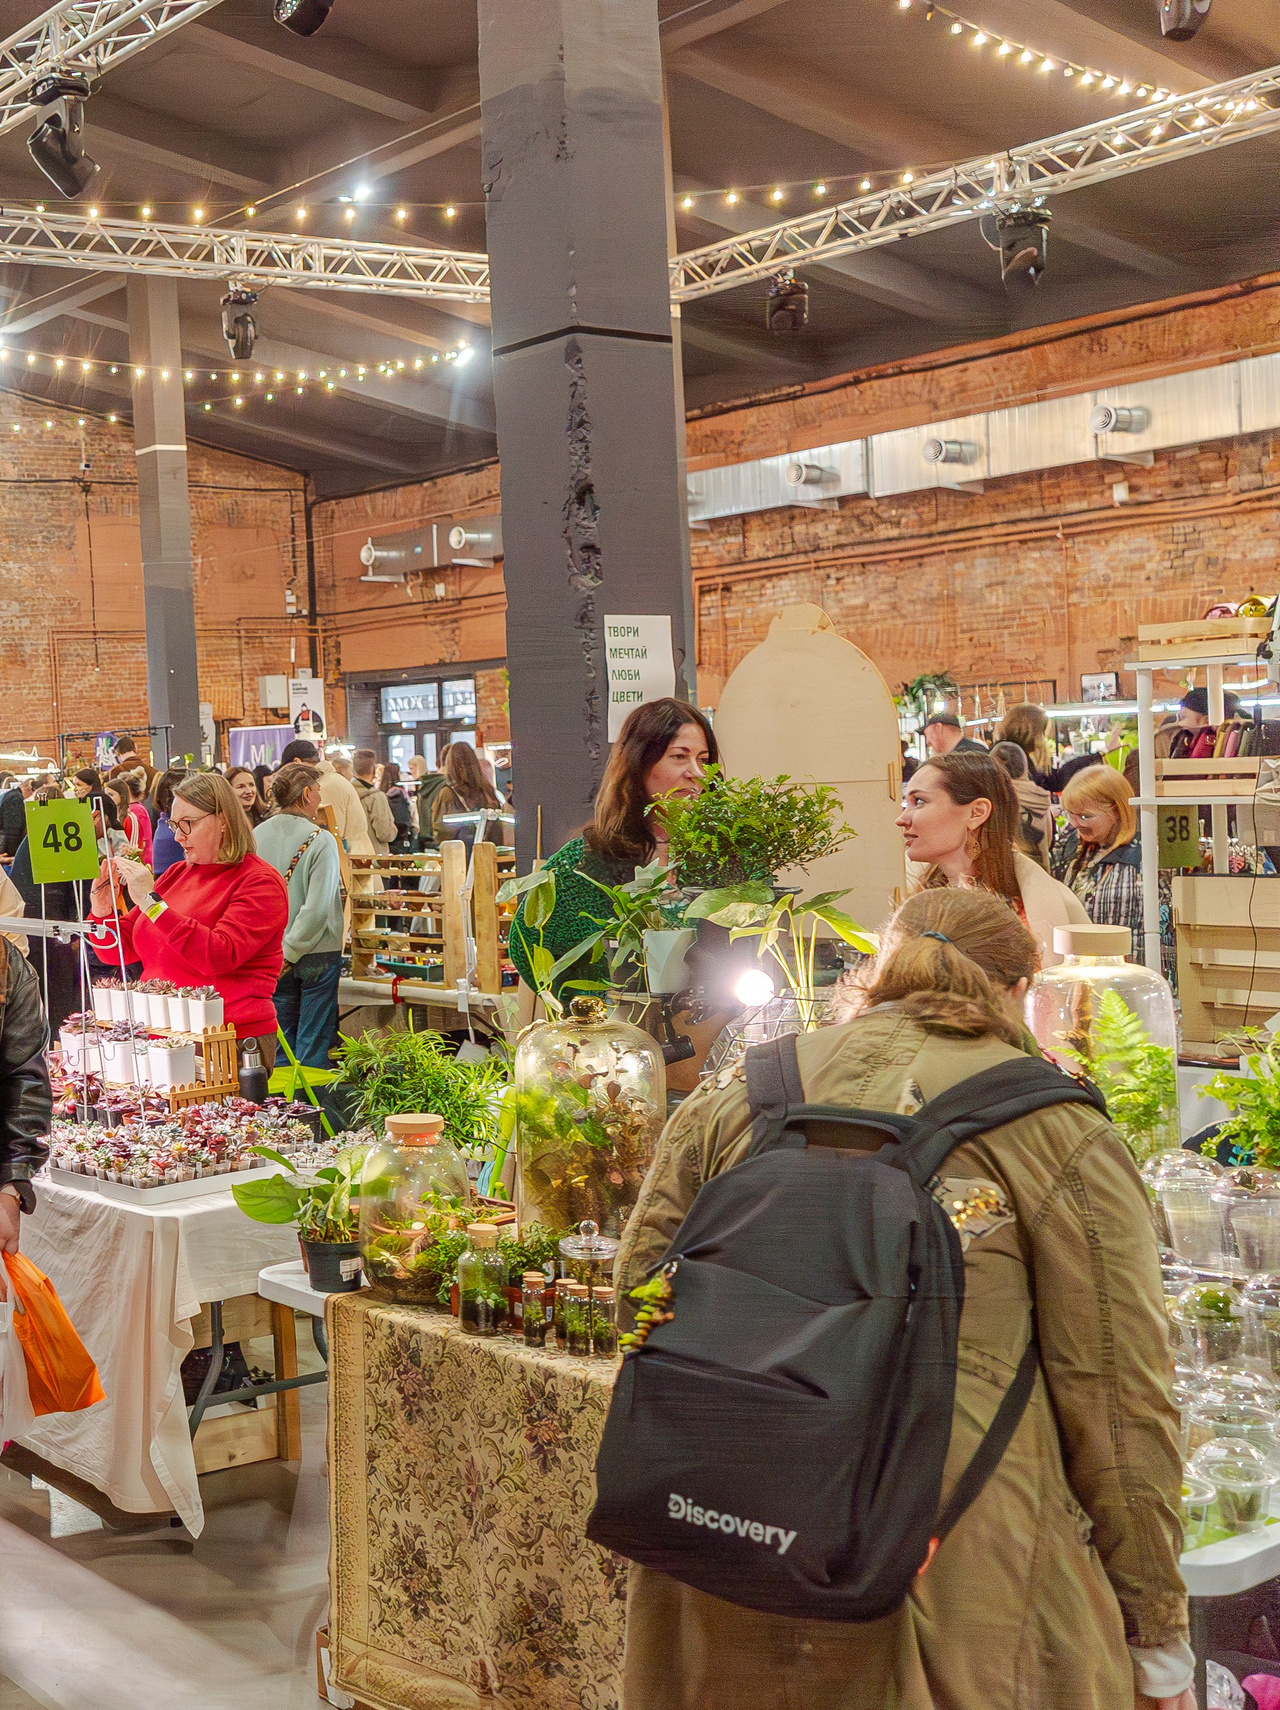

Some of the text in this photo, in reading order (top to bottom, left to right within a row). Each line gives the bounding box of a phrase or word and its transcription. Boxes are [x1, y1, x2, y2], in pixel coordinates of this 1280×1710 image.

[607, 626, 640, 638] ТВОРИ
[609, 645, 648, 660] МЕЧТАЙ
[611, 669, 641, 681] ЛЮБИ
[612, 690, 643, 704] ЦВЕТИ
[1165, 815, 1190, 843] 38
[42, 821, 83, 853] 48
[667, 1493, 798, 1555] Discovery
